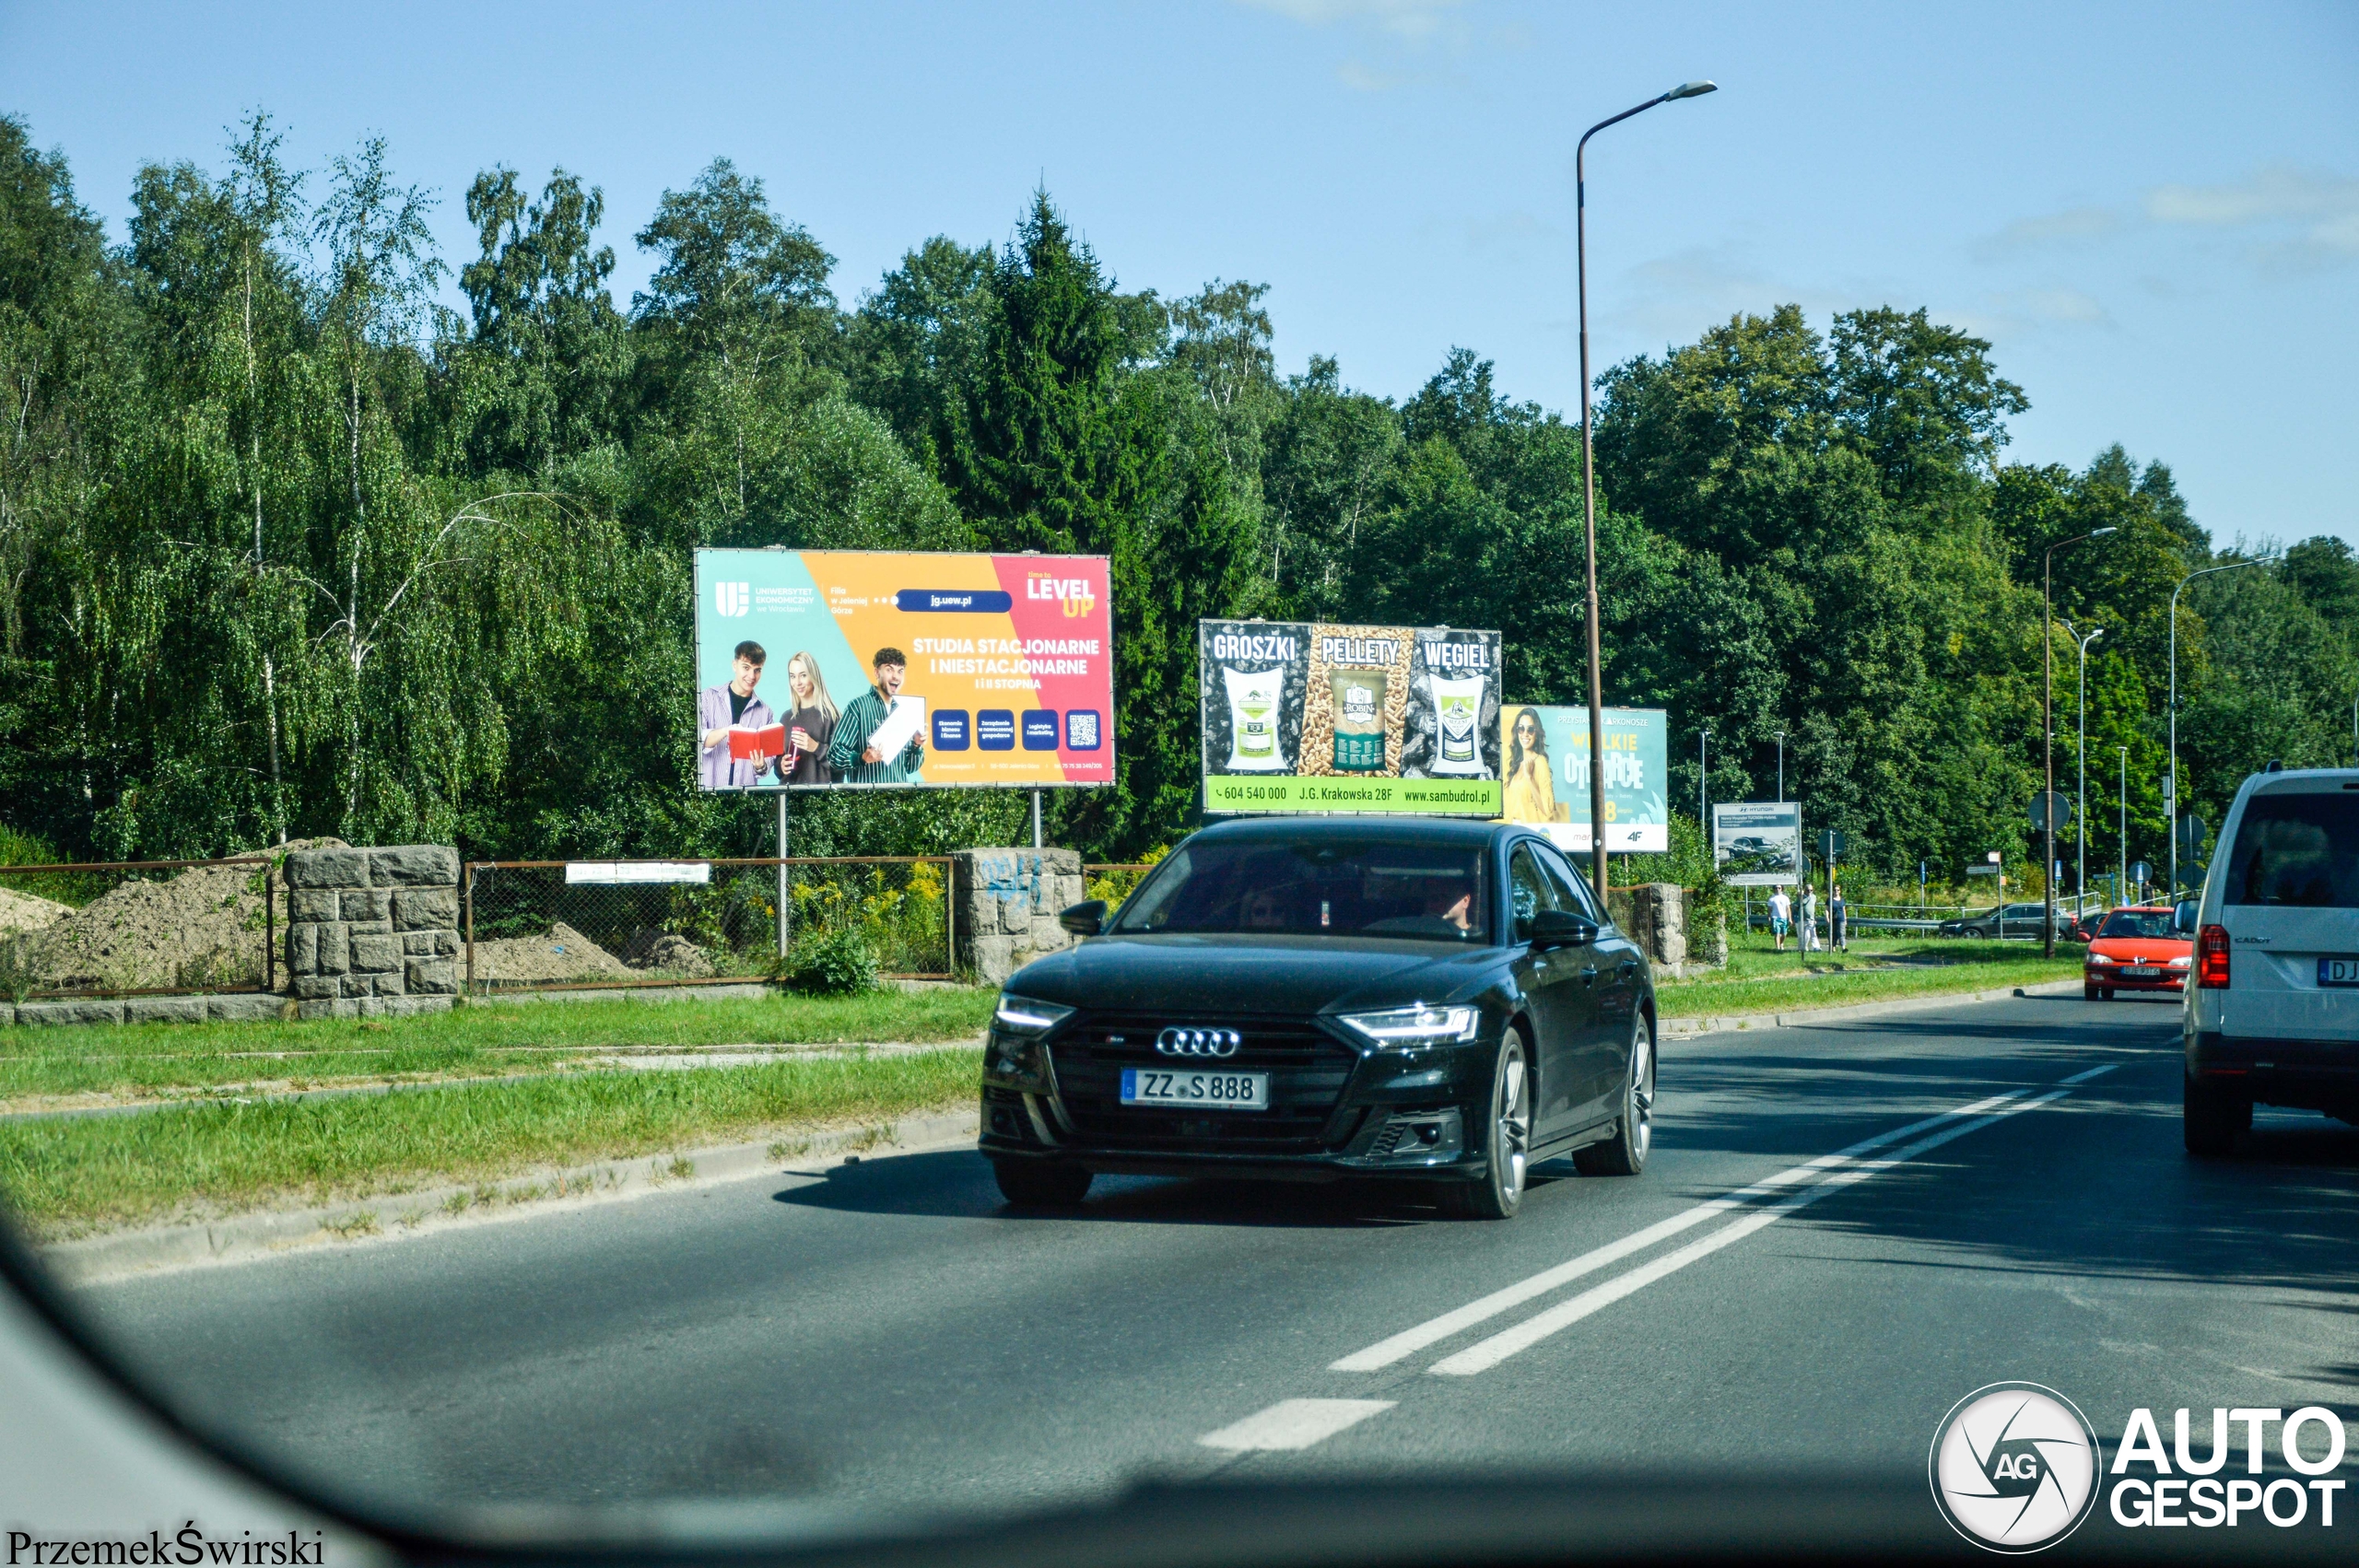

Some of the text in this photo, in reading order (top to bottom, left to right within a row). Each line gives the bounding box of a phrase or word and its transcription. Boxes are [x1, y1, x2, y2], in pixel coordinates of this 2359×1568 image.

[755, 587, 813, 595] UNIWERSYTET
[830, 587, 846, 595] Filia
[1027, 579, 1095, 600] LEVEL
[756, 596, 814, 604] EKONOMICZNY
[839, 597, 868, 606] Jeleniej
[931, 595, 971, 607] jg.uew.pl
[769, 604, 805, 613] Wrocławiu
[830, 605, 853, 615] Górze
[1062, 597, 1094, 618] UP
[913, 638, 1099, 655] STUDIA STACJONARNE
[1214, 635, 1296, 661] GROSZKI
[1322, 638, 1399, 664] PELLETY
[1424, 641, 1490, 670] WĘGIEL
[931, 659, 1087, 674] I NIESTACJONARNE
[975, 678, 1041, 689] I i II STOPNIA
[1346, 703, 1373, 713] ROBIN
[1571, 731, 1637, 751] WILKIE
[1225, 787, 1286, 800] 604 540 000
[1299, 787, 1392, 801] J.G. Krakowska 28F
[1405, 790, 1490, 805] www.sambudrol.pl
[1144, 1073, 1254, 1100] ZZ S 888
